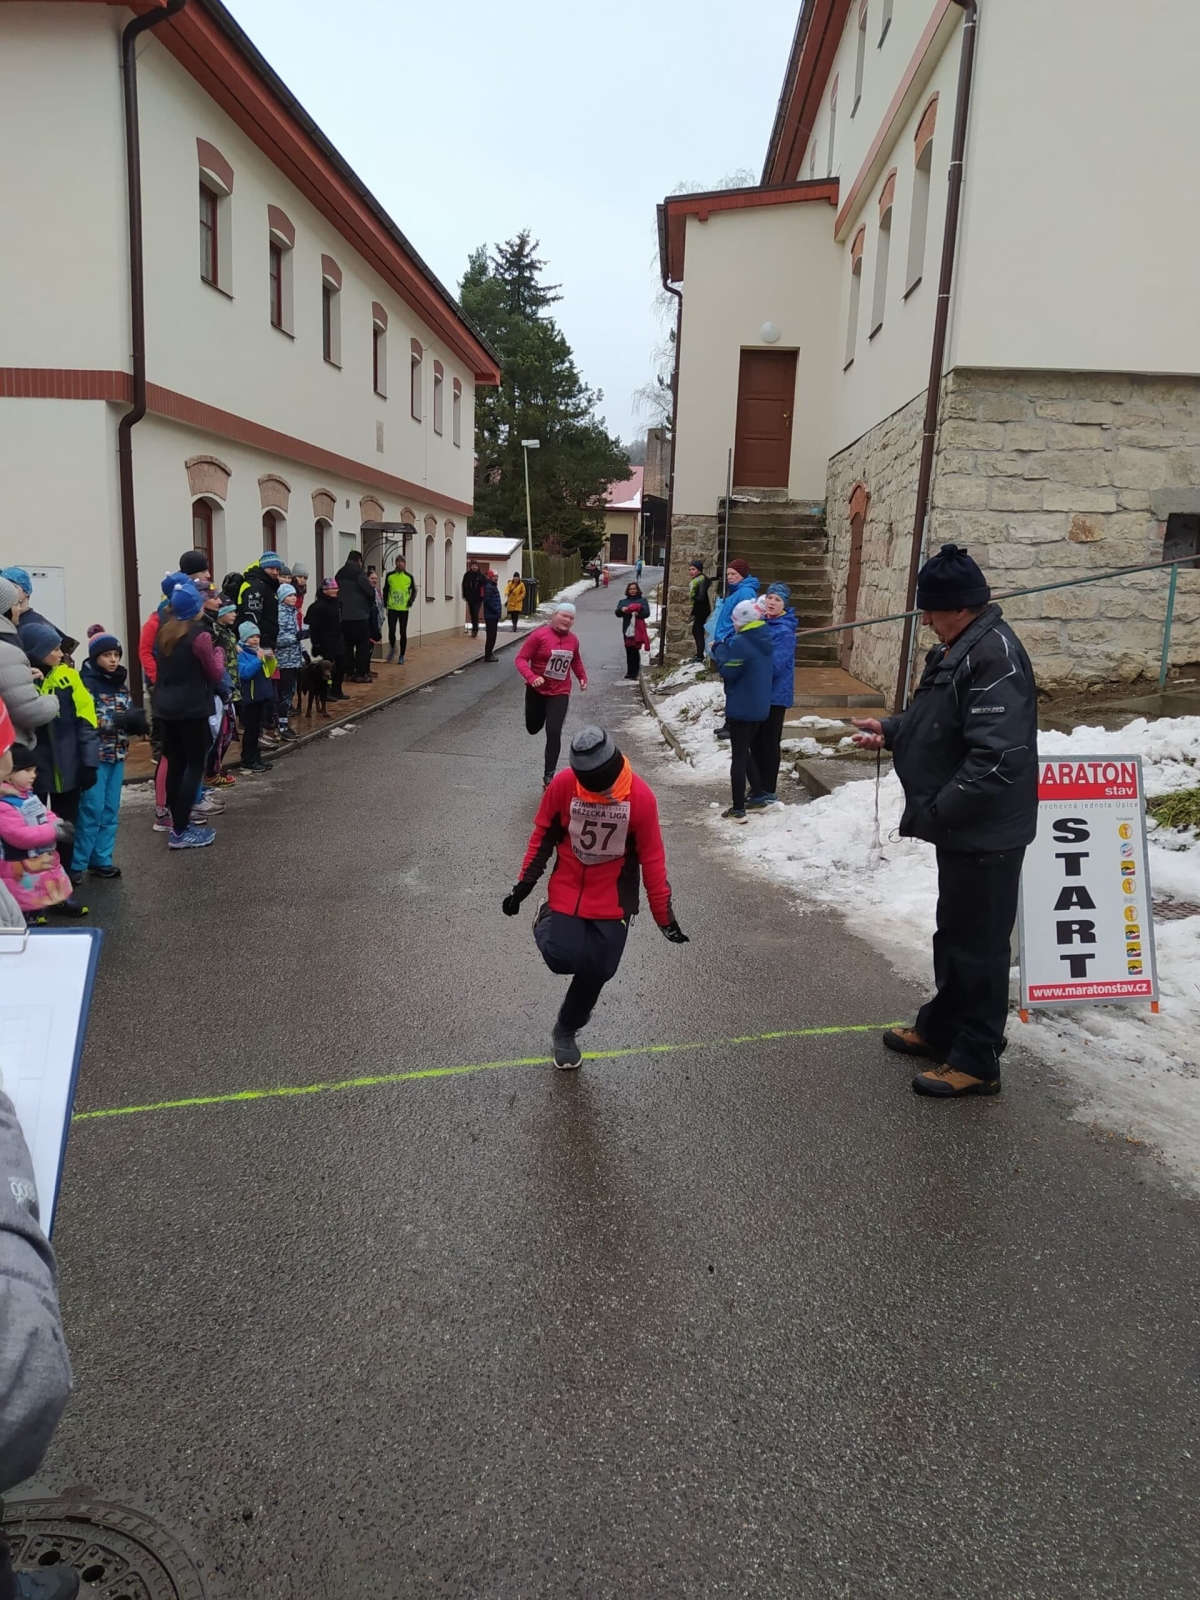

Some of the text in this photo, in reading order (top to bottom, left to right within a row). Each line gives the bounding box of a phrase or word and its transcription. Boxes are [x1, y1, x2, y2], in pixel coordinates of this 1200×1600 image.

[550, 658, 569, 673] 109
[1038, 763, 1137, 784] ARATON
[1105, 786, 1134, 796] stav
[1039, 801, 1139, 811] výchovná jednota Úpice
[609, 811, 627, 820] LIGA
[580, 819, 618, 850] 57
[1053, 817, 1097, 978] START
[1033, 982, 1148, 998] www.maratonstav.cz
